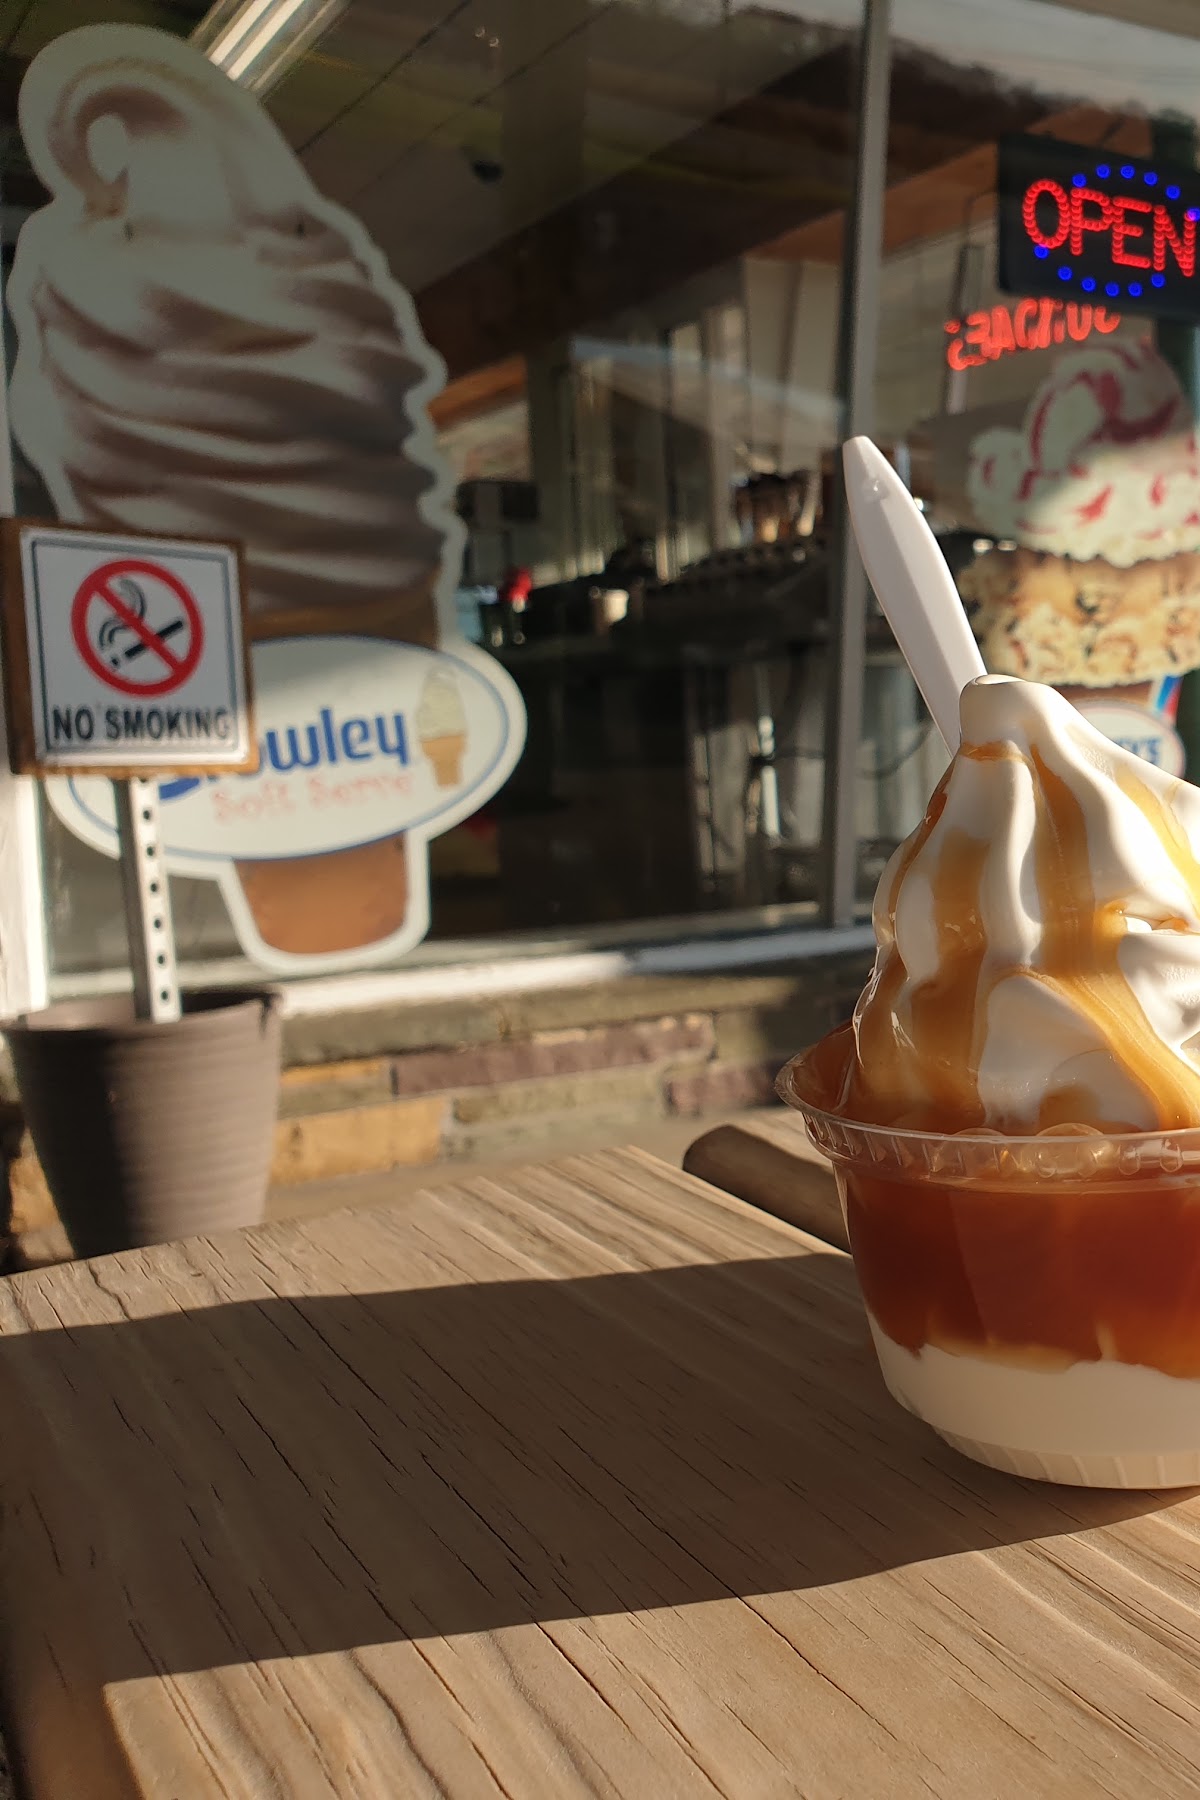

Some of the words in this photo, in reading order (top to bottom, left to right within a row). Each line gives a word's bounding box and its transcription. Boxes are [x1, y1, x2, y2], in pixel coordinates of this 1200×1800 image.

[1023, 179, 1196, 277] OPEN
[53, 704, 95, 741] NO
[105, 704, 231, 741] SMOKING
